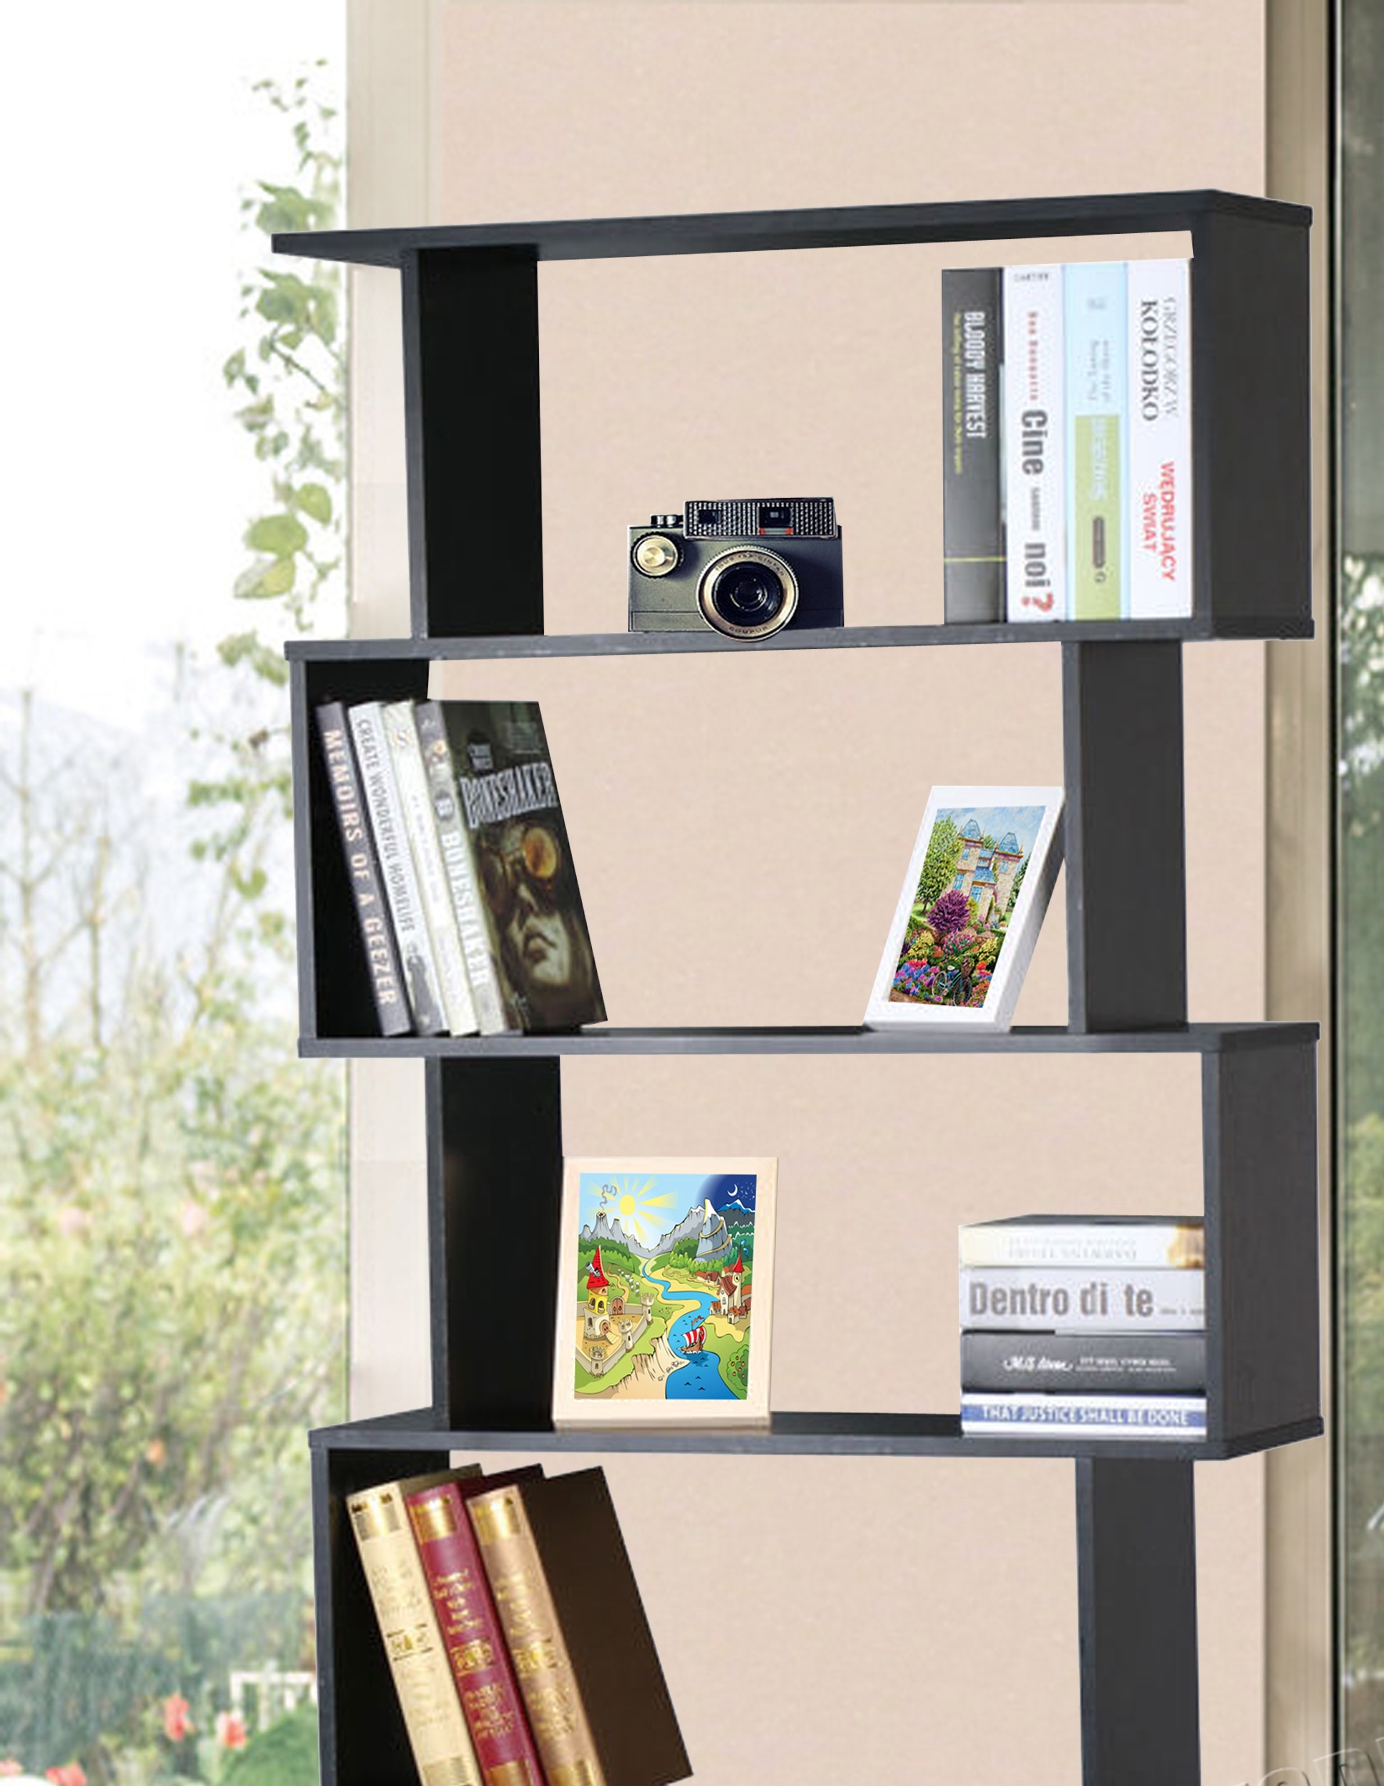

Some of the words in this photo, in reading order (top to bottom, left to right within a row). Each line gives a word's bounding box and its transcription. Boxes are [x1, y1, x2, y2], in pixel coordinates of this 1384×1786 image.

[964, 312, 986, 369] BLOODY
[965, 373, 987, 438] HARVEST
[1021, 410, 1048, 475] Cine
[323, 729, 363, 842] MEMOIRS
[357, 719, 380, 769] CREATE
[370, 772, 400, 860] WONDERFUL
[389, 863, 415, 931] HOMELIFE
[351, 853, 370, 880] OF
[358, 893, 375, 906] A
[364, 918, 395, 1004] GEEZER
[969, 1282, 1069, 1316] Dentro
[1079, 1282, 1108, 1316] di
[1125, 1284, 1153, 1317] te
[983, 1405, 1018, 1420] THAT
[1021, 1405, 1076, 1423] JUSTICE
[1079, 1407, 1124, 1423] SHALL
[1127, 1408, 1145, 1424] BE
[1148, 1408, 1188, 1425] DONE
